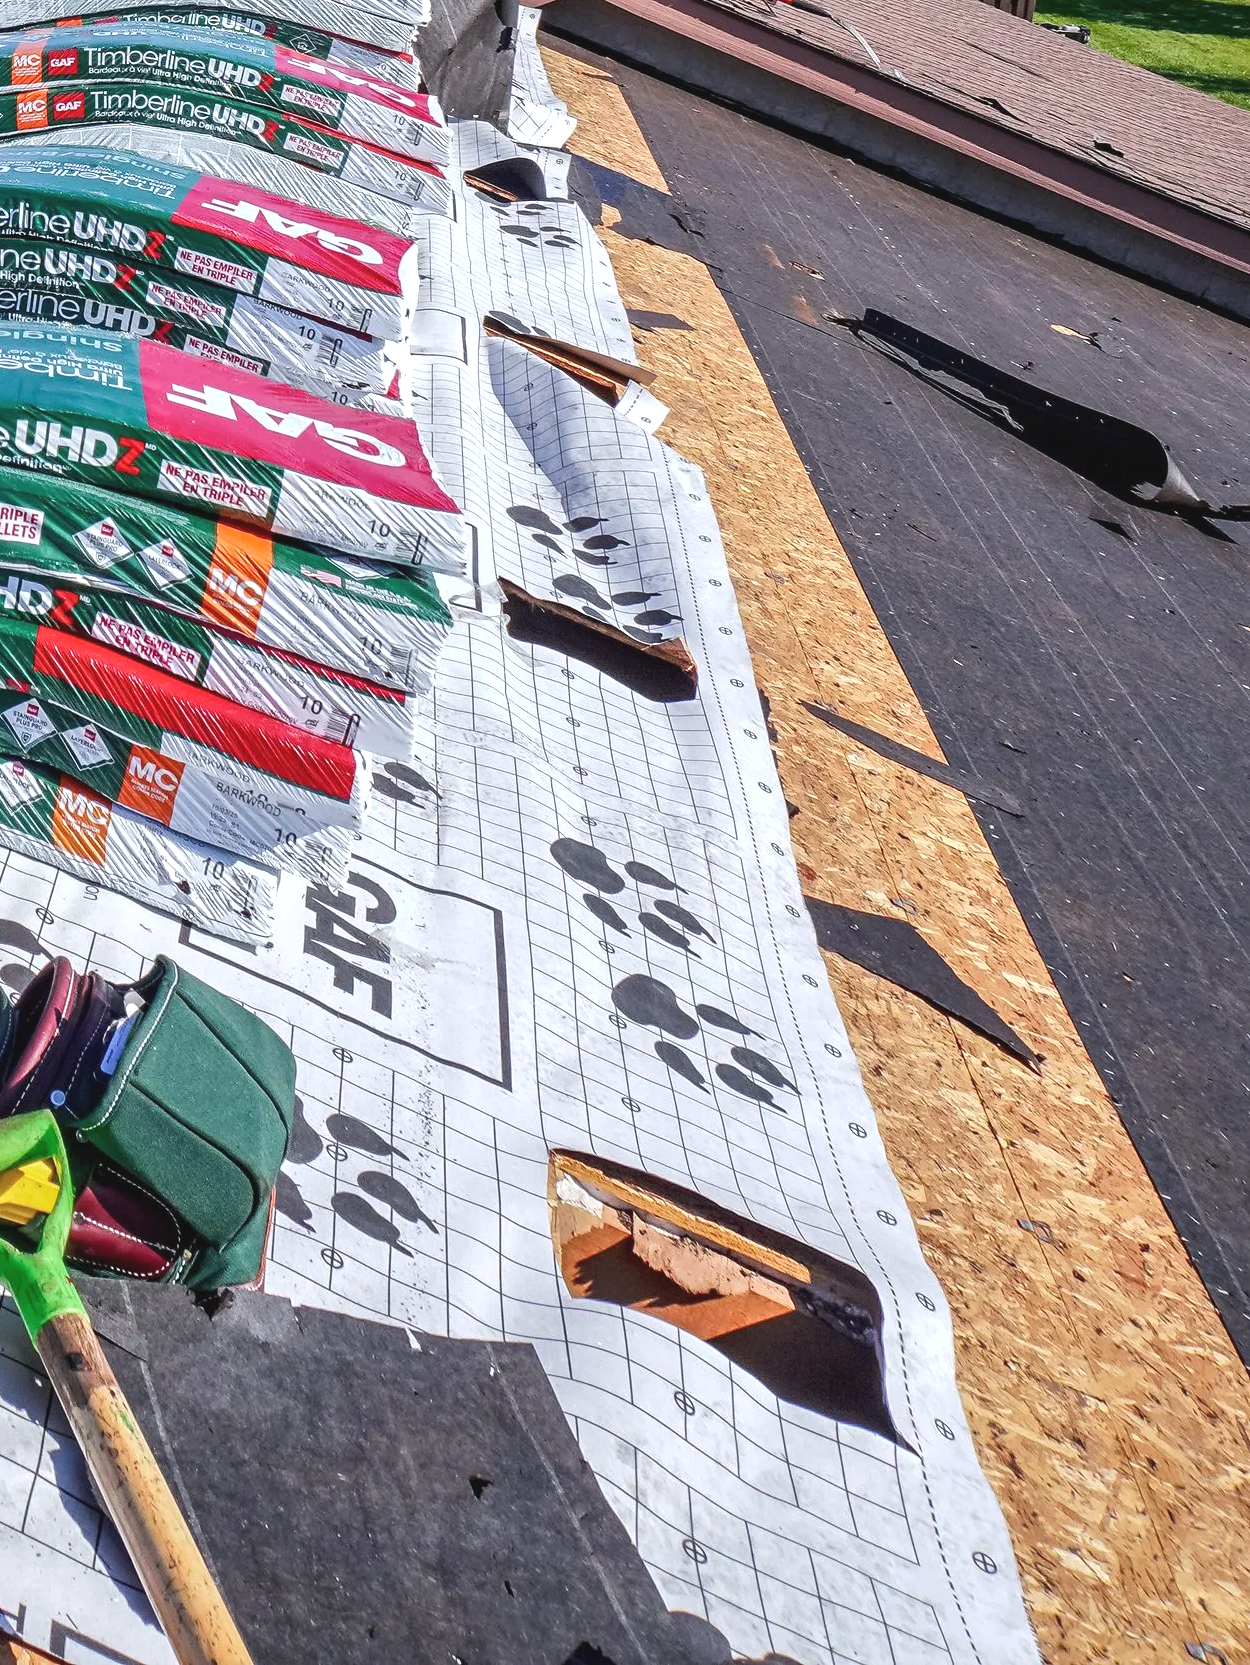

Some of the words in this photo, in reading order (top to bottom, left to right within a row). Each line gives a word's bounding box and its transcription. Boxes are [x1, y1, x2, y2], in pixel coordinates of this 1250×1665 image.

[14, 54, 41, 68] MC
[50, 56, 76, 69] GAF
[83, 45, 206, 75] Timberline
[18, 99, 47, 114] MC
[55, 100, 82, 113] GAF
[90, 91, 210, 121] Timberline
[73, 211, 166, 260] UHDZ
[201, 199, 384, 265] GAF
[0, 270, 26, 283] High
[43, 247, 136, 292] UHDZ
[181, 251, 193, 261] NE
[194, 254, 212, 266] PAS
[213, 259, 254, 282] EMPILER
[191, 264, 205, 275] EN
[206, 267, 238, 286] TRIPLE
[299, 324, 317, 340] 10
[188, 337, 201, 349] NE
[202, 342, 220, 357] PAS
[220, 348, 259, 373] EMPILER
[331, 390, 349, 406] 10
[166, 383, 406, 468] GAF
[14, 418, 145, 477] UHDZ
[166, 462, 181, 477] NE
[184, 466, 210, 484] PAS
[211, 473, 267, 501] EMPILER
[182, 481, 200, 493] EN
[201, 485, 245, 507] TRIPLE
[367, 518, 393, 538] 10
[208, 567, 263, 607] MC
[100, 615, 116, 631] NE
[299, 694, 324, 715] 10
[11, 710, 49, 731] STAINGUARD
[14, 718, 30, 729] PLUS
[30, 721, 44, 732] PRO
[127, 756, 180, 793] MC
[58, 786, 111, 825] MC
[215, 781, 282, 818] BARKWOOD
[274, 827, 298, 847] 10
[202, 856, 225, 881] 10
[304, 869, 398, 1021] GAF
